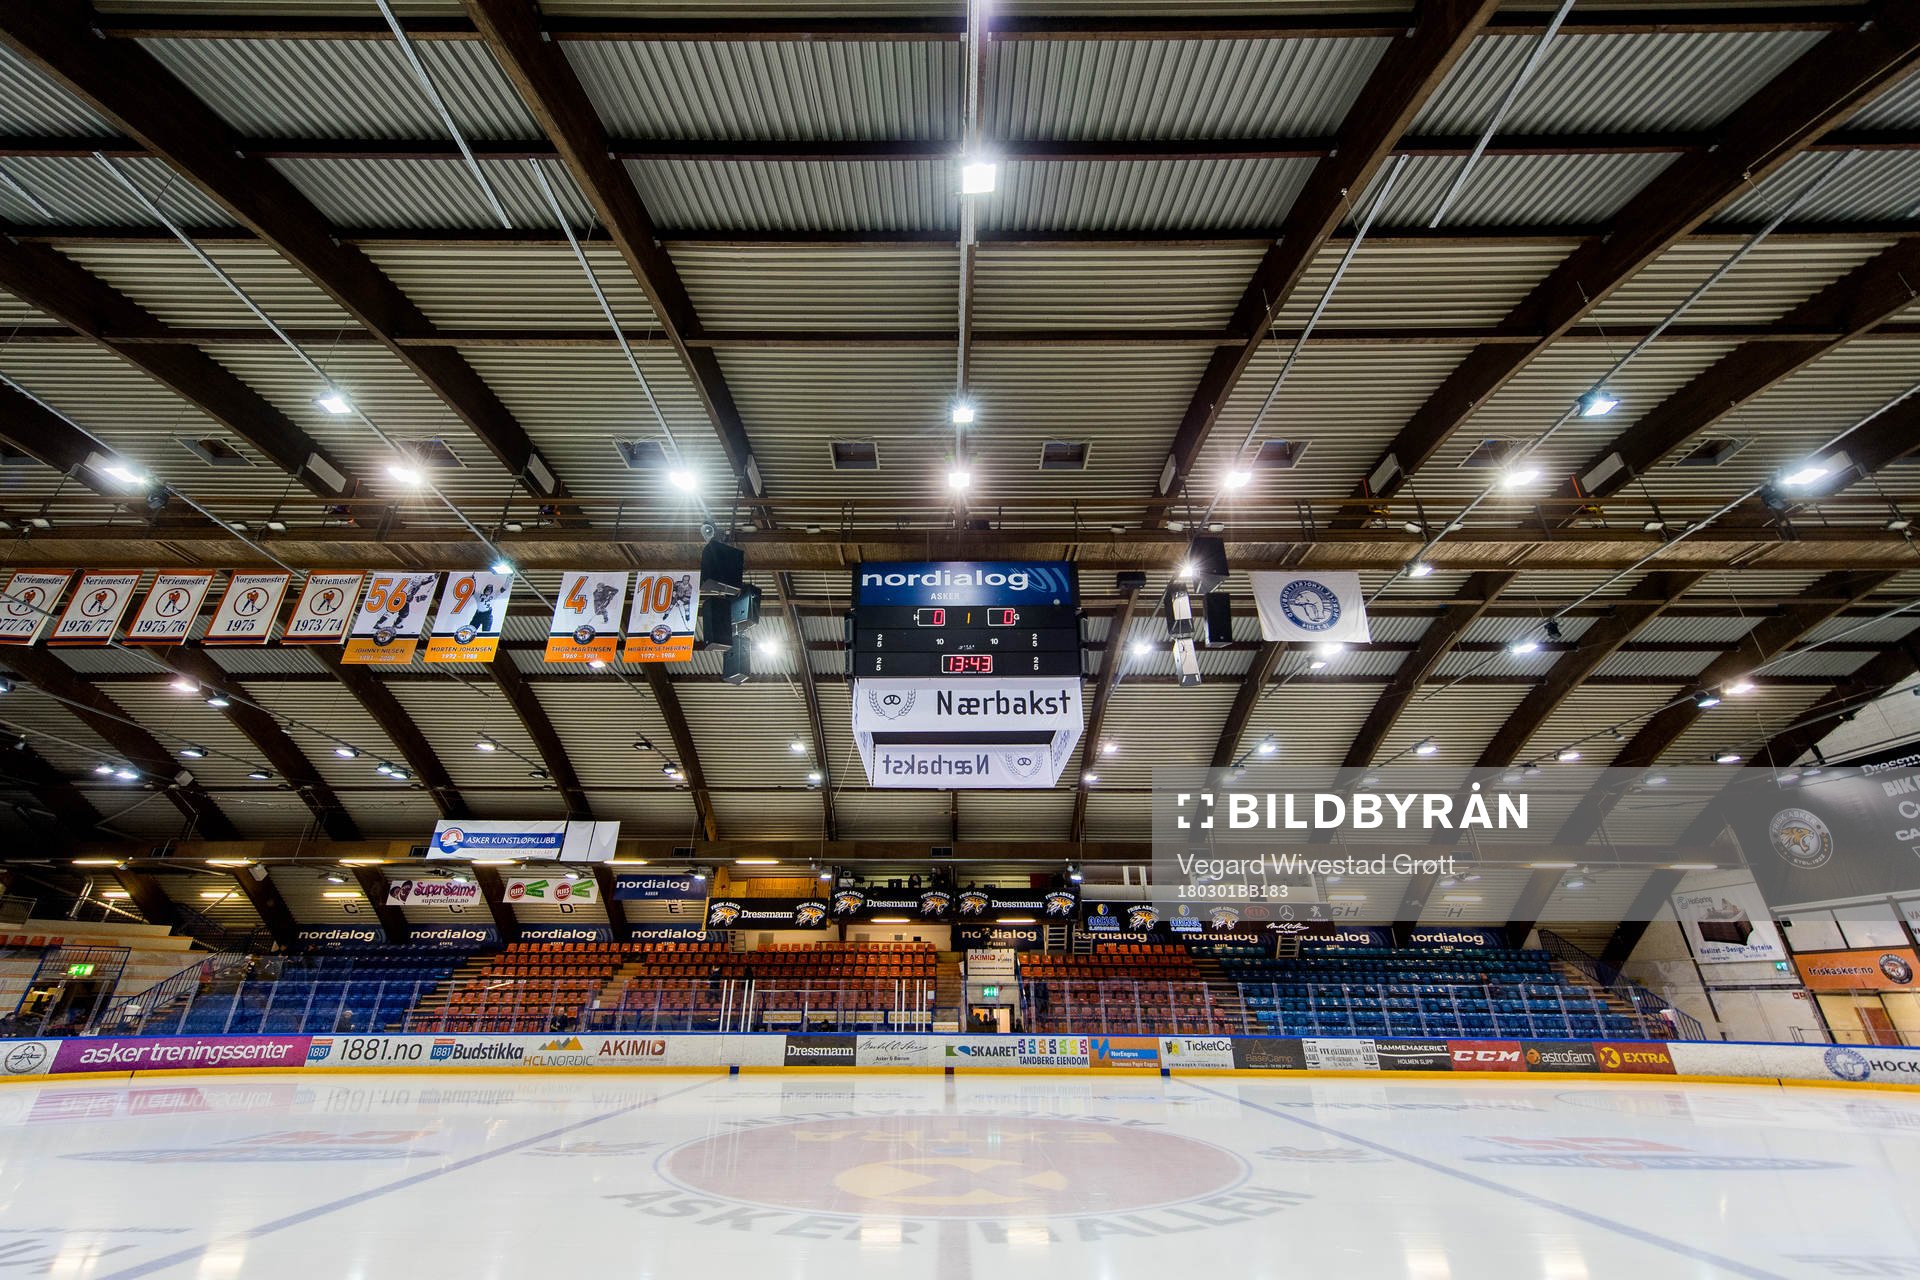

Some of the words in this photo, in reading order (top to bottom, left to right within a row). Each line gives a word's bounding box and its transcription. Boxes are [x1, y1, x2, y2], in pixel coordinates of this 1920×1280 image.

[14, 574, 65, 586] Seriemester
[82, 575, 135, 587] Seriemester
[156, 575, 208, 587] Seriemester
[233, 574, 287, 586] Norgesmester
[309, 574, 361, 586] Seriemester
[861, 569, 1028, 591] nordialog
[365, 577, 411, 615] 56
[451, 576, 477, 615] 9
[564, 576, 589, 614] 4
[637, 577, 673, 614] 10
[930, 592, 960, 601] ASKER
[935, 609, 944, 625] 0
[1004, 609, 1014, 625] 0
[1013, 613, 1020, 621] G
[0, 618, 38, 632] 77/78
[60, 619, 114, 633] 1976/77
[135, 619, 186, 633] 1975/76
[226, 618, 256, 632] 1975
[293, 618, 345, 632] 1973/74
[877, 633, 883, 641] 2
[936, 637, 945, 645] 10
[990, 637, 999, 645] 10
[1032, 633, 1038, 641] 2
[876, 640, 882, 648] 5
[1032, 640, 1038, 648] 5
[949, 656, 991, 672] 13:43
[1033, 656, 1039, 664] 2
[937, 690, 1071, 716] Nærbakst
[1898, 801, 1920, 819] C
[466, 837, 490, 845] ASKER
[492, 836, 556, 845] KUNSTLØPKLUBB
[414, 882, 477, 897] SuperSelma
[616, 879, 691, 891] nordialog
[849, 890, 865, 899] ASKER
[935, 890, 951, 899] ASKER
[973, 891, 989, 900] ASKER
[1059, 891, 1075, 900] ASKER
[421, 896, 469, 906] superselma.no
[866, 899, 918, 908] Dressmann
[991, 899, 1043, 908] Dressmann
[344, 903, 358, 914] C
[560, 903, 574, 914] D
[668, 903, 681, 914] E
[741, 910, 794, 919] Dressmann
[1447, 907, 1463, 918] H
[298, 928, 375, 942] nordialog
[410, 928, 487, 942] nordialog
[521, 929, 597, 941] nordialog
[632, 929, 708, 941] nordialog
[1808, 966, 1874, 977] friskasker.no
[309, 1047, 330, 1057] 1881
[340, 1039, 423, 1061] 1881.no
[432, 1047, 452, 1057] 1881
[452, 1042, 524, 1061] Budstikka
[787, 1045, 855, 1057] Dressmann
[971, 1045, 1018, 1058] SKAARET
[1185, 1040, 1232, 1052] TicketCo
[1377, 1044, 1448, 1053] RAMMEMAKERIET
[80, 1043, 151, 1065] asker
[150, 1041, 293, 1067] treningssenter
[1453, 1049, 1521, 1063] CCM
[1541, 1049, 1596, 1064] astrofarm
[1623, 1052, 1669, 1065] EXTRA
[1019, 1056, 1055, 1066] TANDBERG
[1056, 1056, 1089, 1066] EIENDOM
